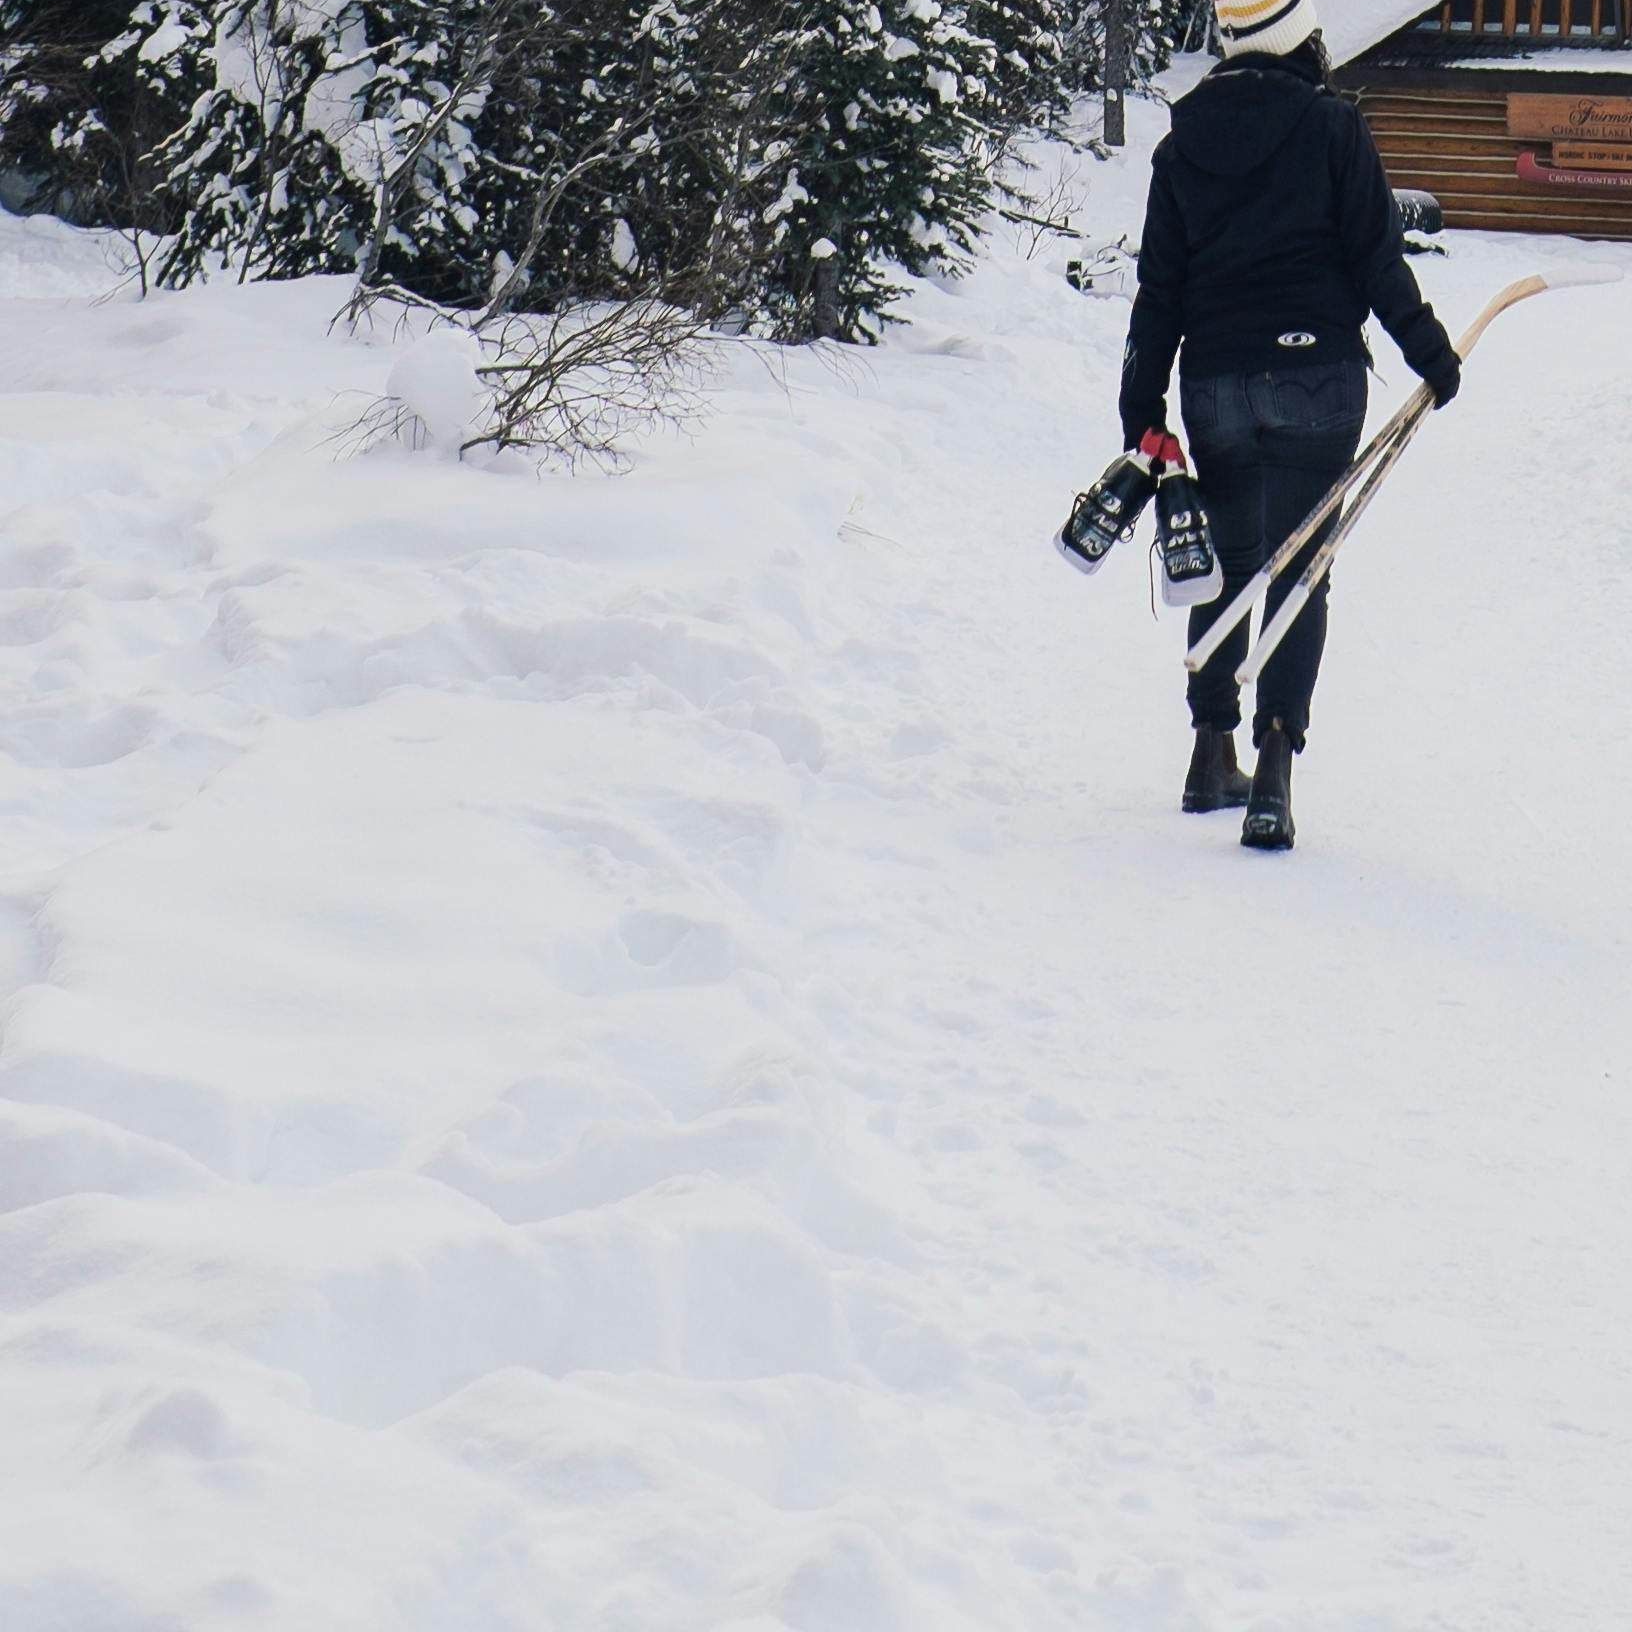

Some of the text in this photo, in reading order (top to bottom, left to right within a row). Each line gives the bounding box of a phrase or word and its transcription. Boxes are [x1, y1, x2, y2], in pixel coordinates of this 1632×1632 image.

[1602, 127, 1625, 138] LAKE
[1548, 175, 1576, 184] CROSS
[1577, 175, 1618, 185] COUNTRY
[1620, 177, 1632, 186] SKI
